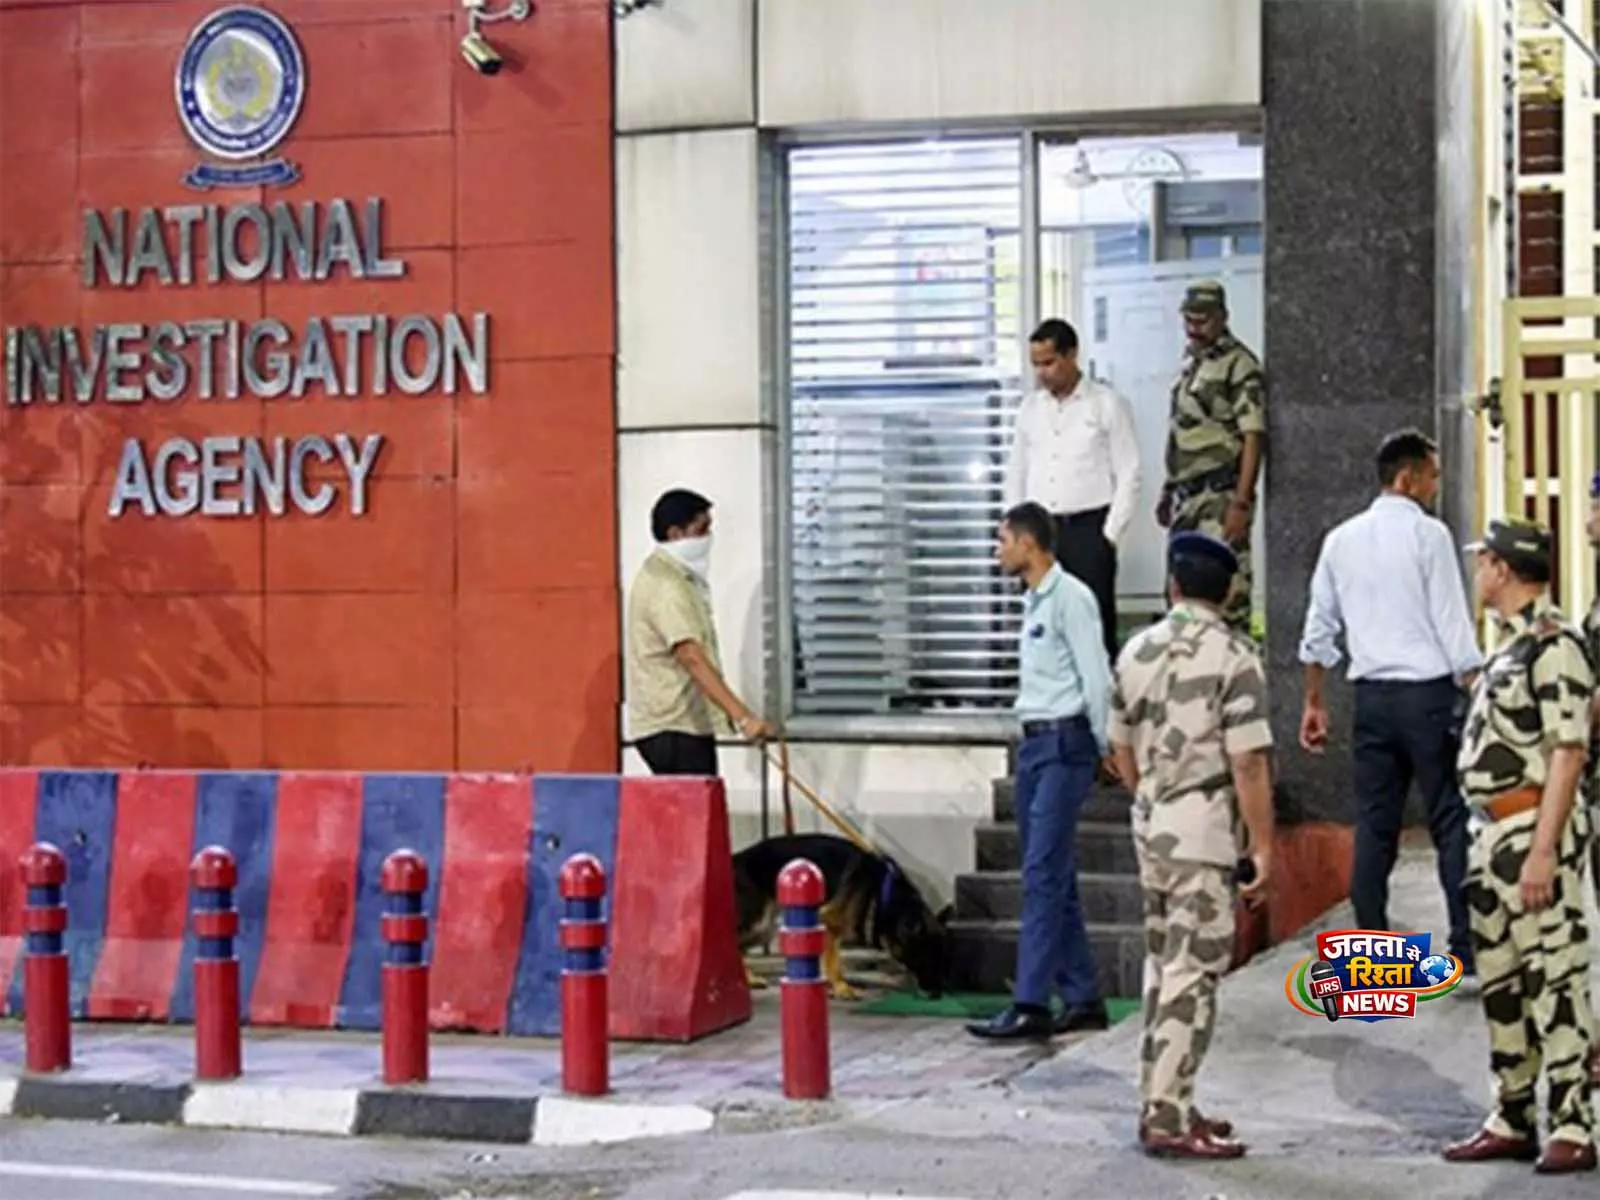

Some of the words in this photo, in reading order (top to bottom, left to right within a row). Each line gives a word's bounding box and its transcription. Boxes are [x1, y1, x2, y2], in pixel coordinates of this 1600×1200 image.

[83, 197, 404, 285] NATIONAL
[5, 313, 488, 402] INVESTIGATION
[108, 434, 384, 516] AGENCY
